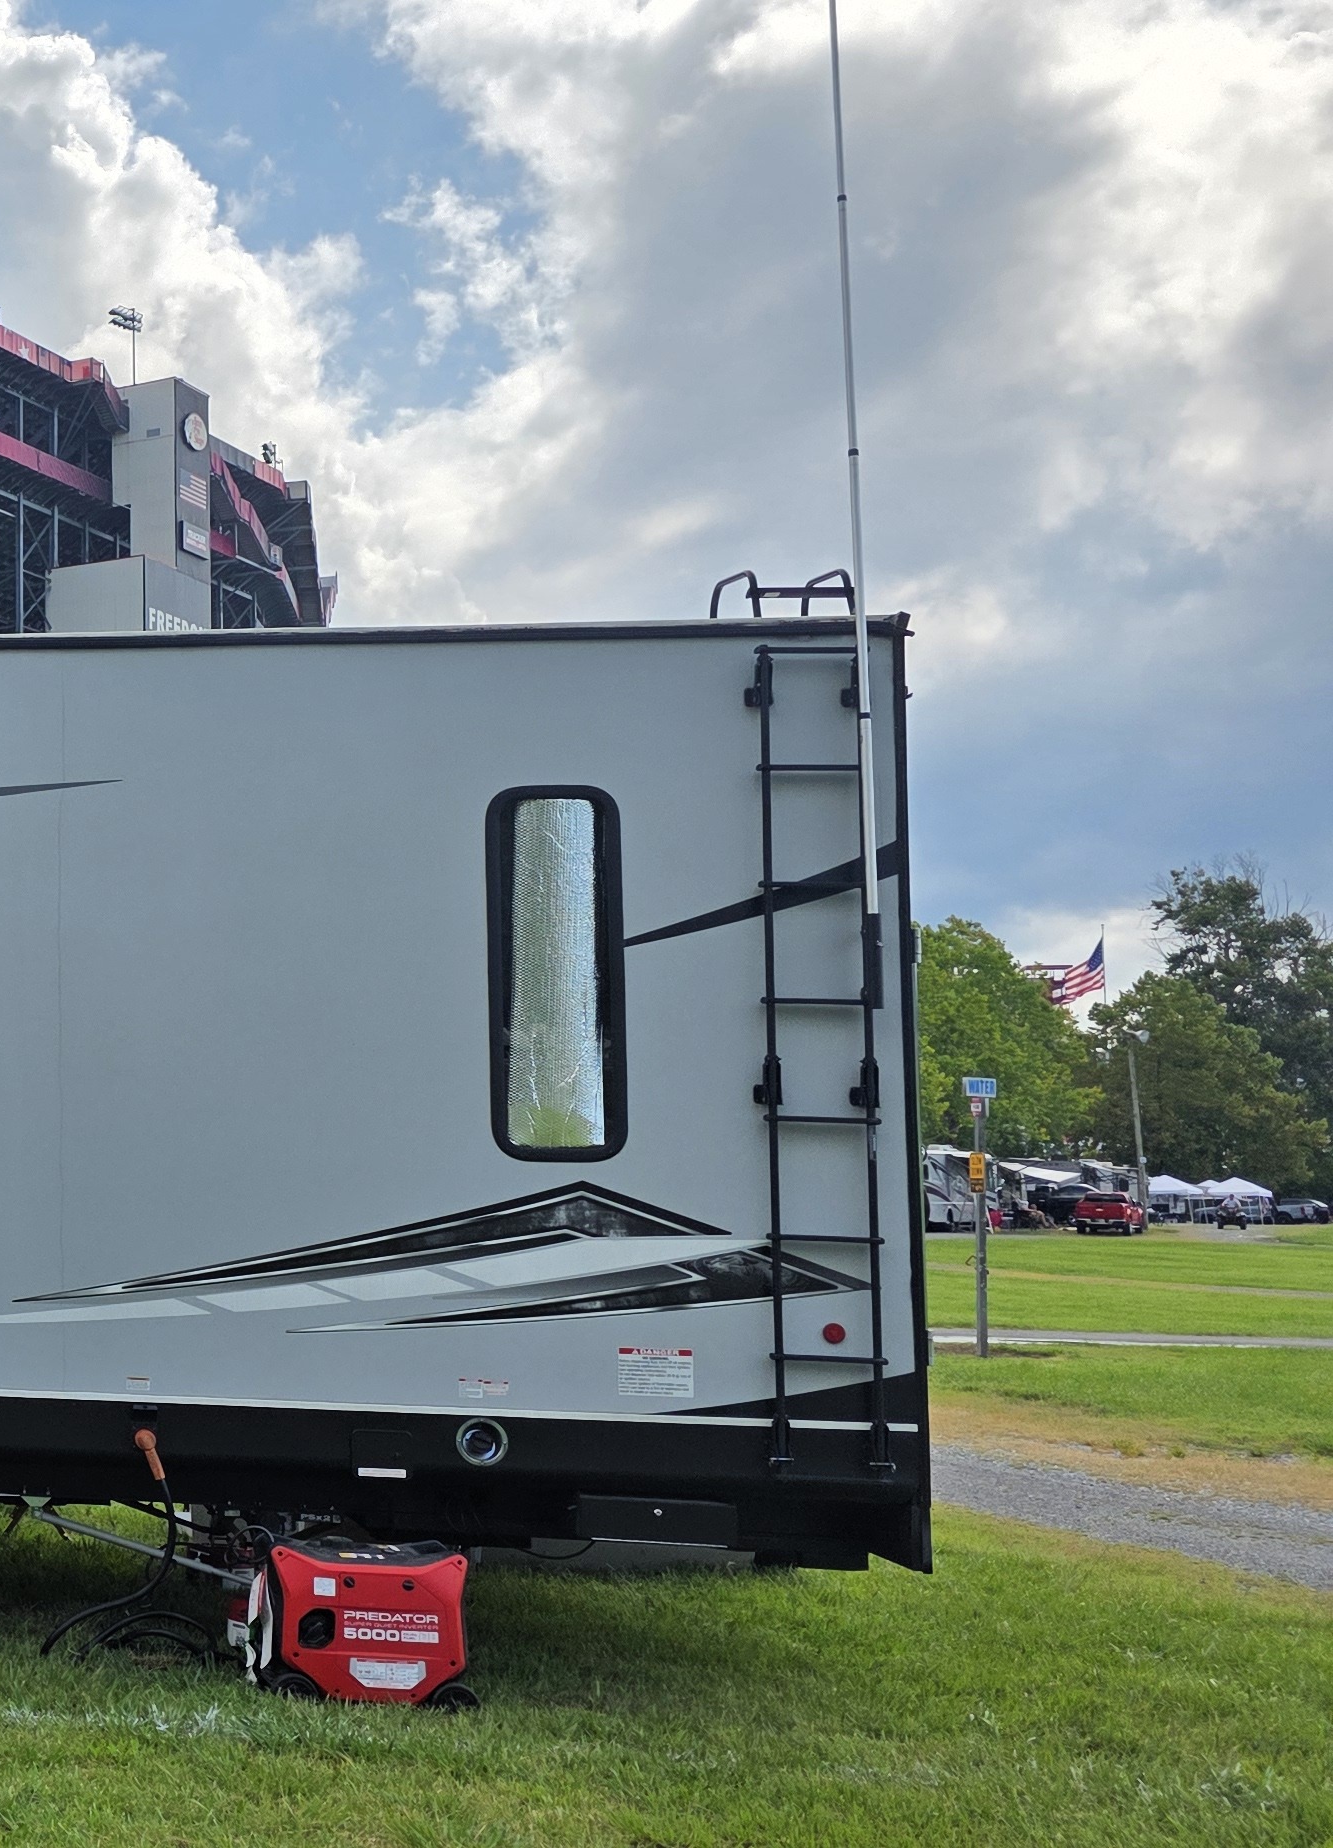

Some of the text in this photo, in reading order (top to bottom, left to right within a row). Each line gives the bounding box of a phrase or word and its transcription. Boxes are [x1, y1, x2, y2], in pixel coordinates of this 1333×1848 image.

[968, 1079, 996, 1095] WATER
[343, 1611, 438, 1624] PREDATOR
[343, 1627, 400, 1642] 5000
